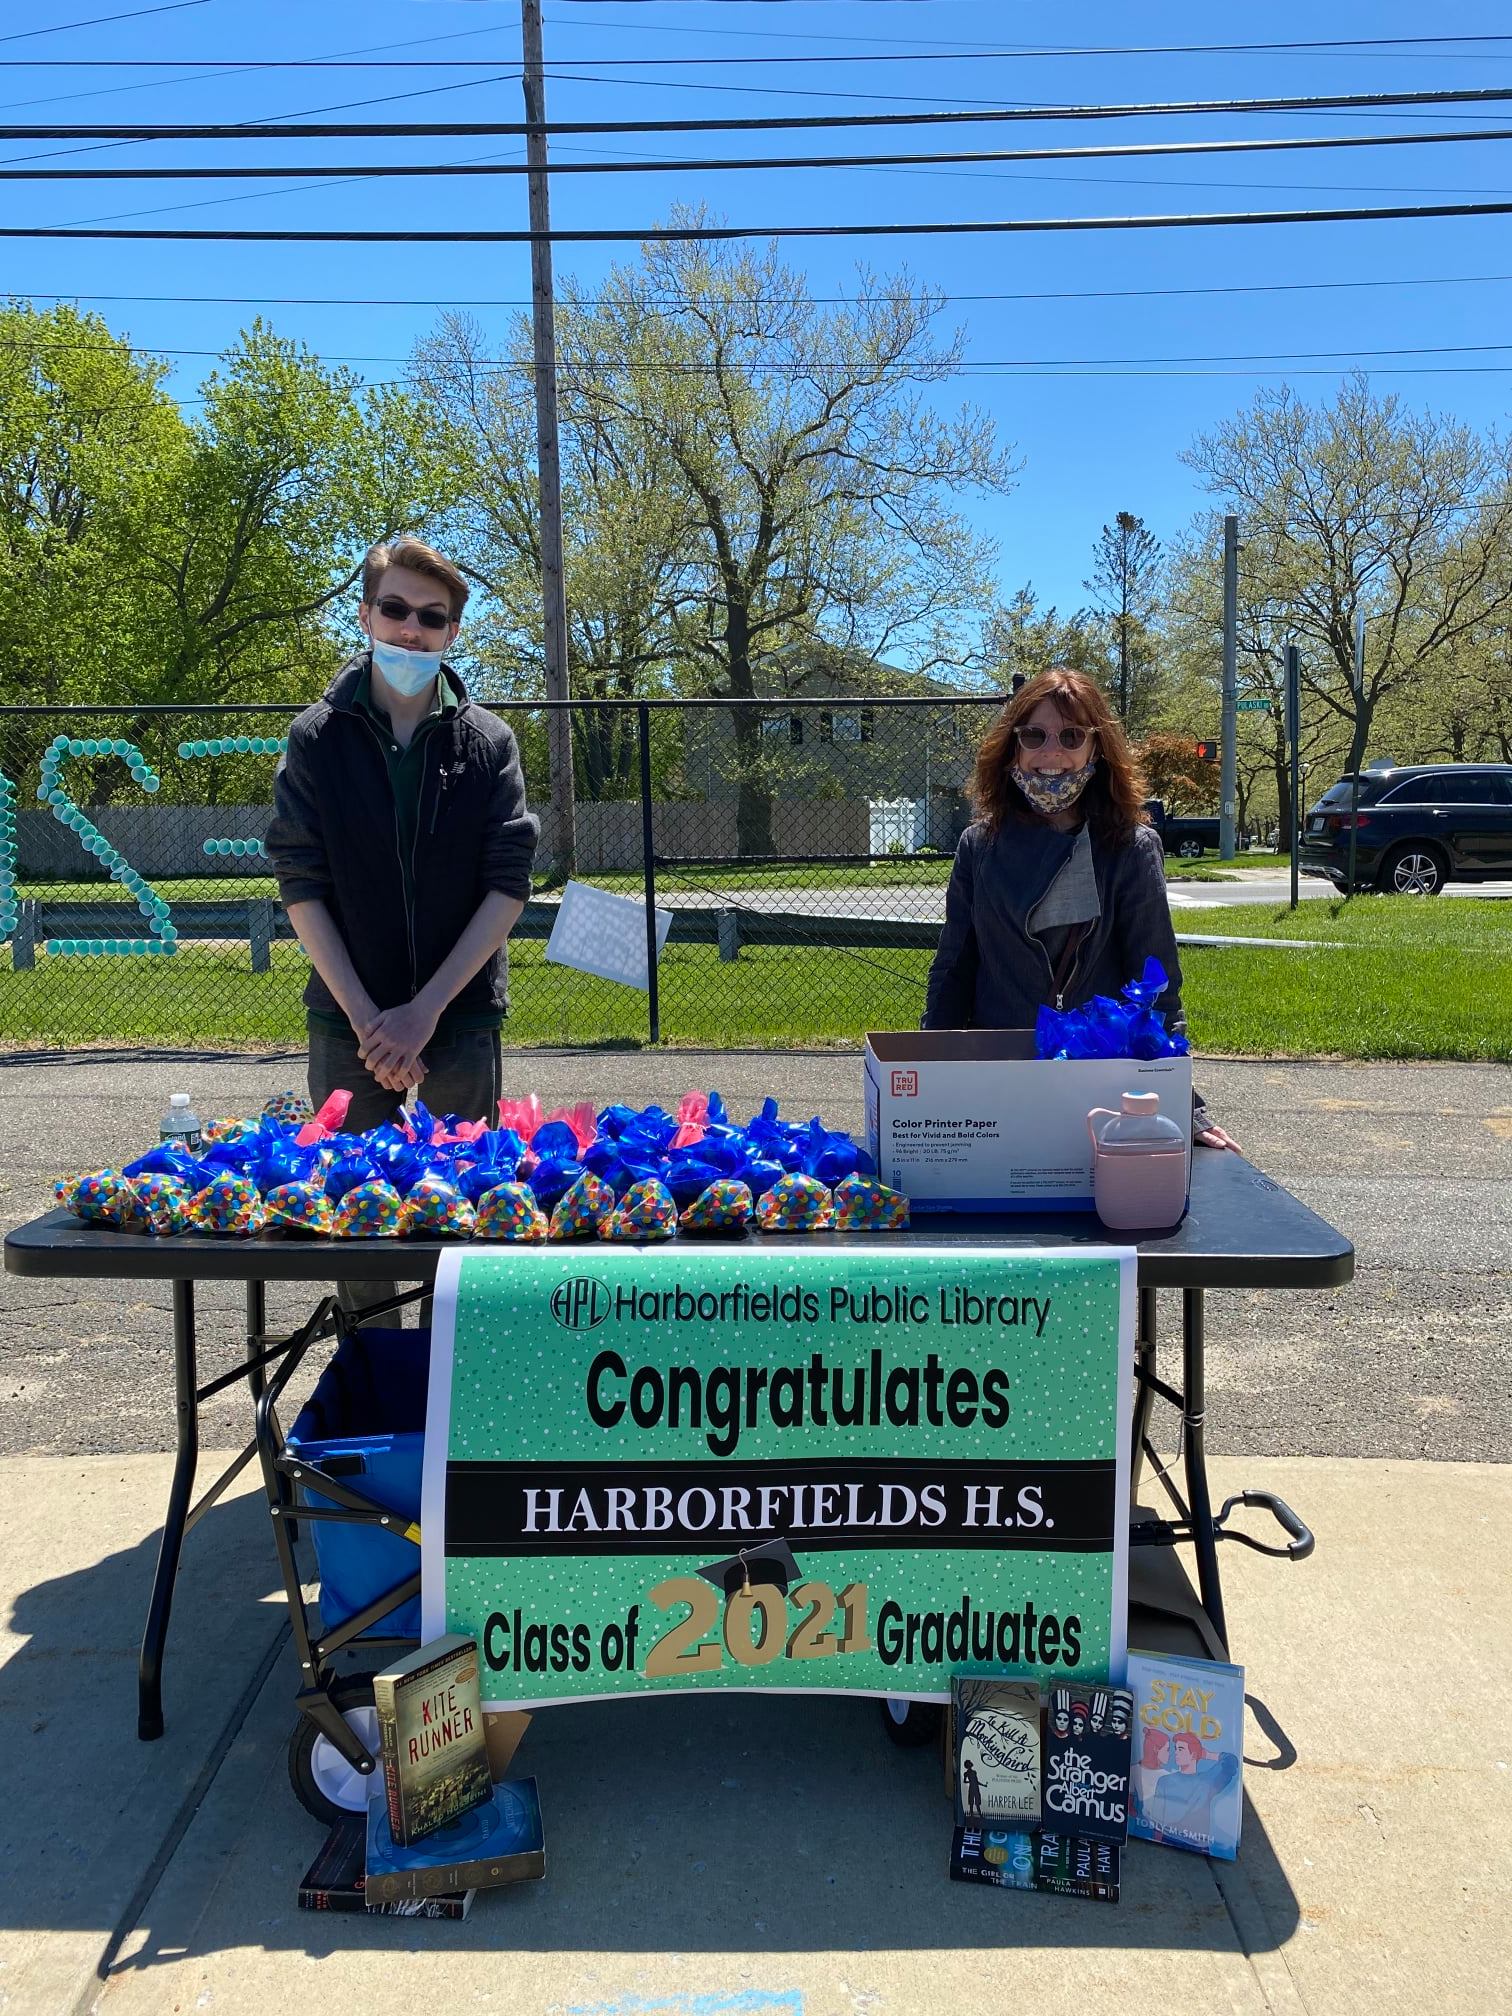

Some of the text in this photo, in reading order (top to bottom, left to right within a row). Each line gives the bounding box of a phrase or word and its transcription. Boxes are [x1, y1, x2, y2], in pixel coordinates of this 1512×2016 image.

[892, 1119, 998, 1129] Color Printer Paper
[616, 1285, 819, 1324] Harborfields
[831, 1285, 928, 1325] Public
[941, 1288, 1051, 1336] Library
[586, 1349, 1010, 1457] Congratulates
[521, 1484, 1055, 1532] HARBORFIELDS H.S.
[484, 1577, 1081, 1677] Class of 2021 Graduates
[422, 1685, 457, 1726] KITE
[1150, 1680, 1216, 1714] STAY
[408, 1707, 474, 1765] RUNNER
[998, 1720, 1020, 1739] Kill
[1140, 1704, 1222, 1740] GOLD
[968, 1719, 1034, 1772] Mockingbird
[1064, 1747, 1092, 1769] the
[1048, 1756, 1126, 1794] Stranger
[1060, 1781, 1096, 1798] Albert
[988, 1794, 1034, 1810] HARPER LEE
[1046, 1784, 1125, 1822] Camus
[961, 1827, 982, 1858] THE
[1013, 1844, 1032, 1870] ON
[1040, 1832, 1060, 1868] TRA
[1076, 1838, 1091, 1878] PAULA
[1046, 1878, 1070, 1887] PAULA
[1054, 1886, 1090, 1896] HAWKINS
